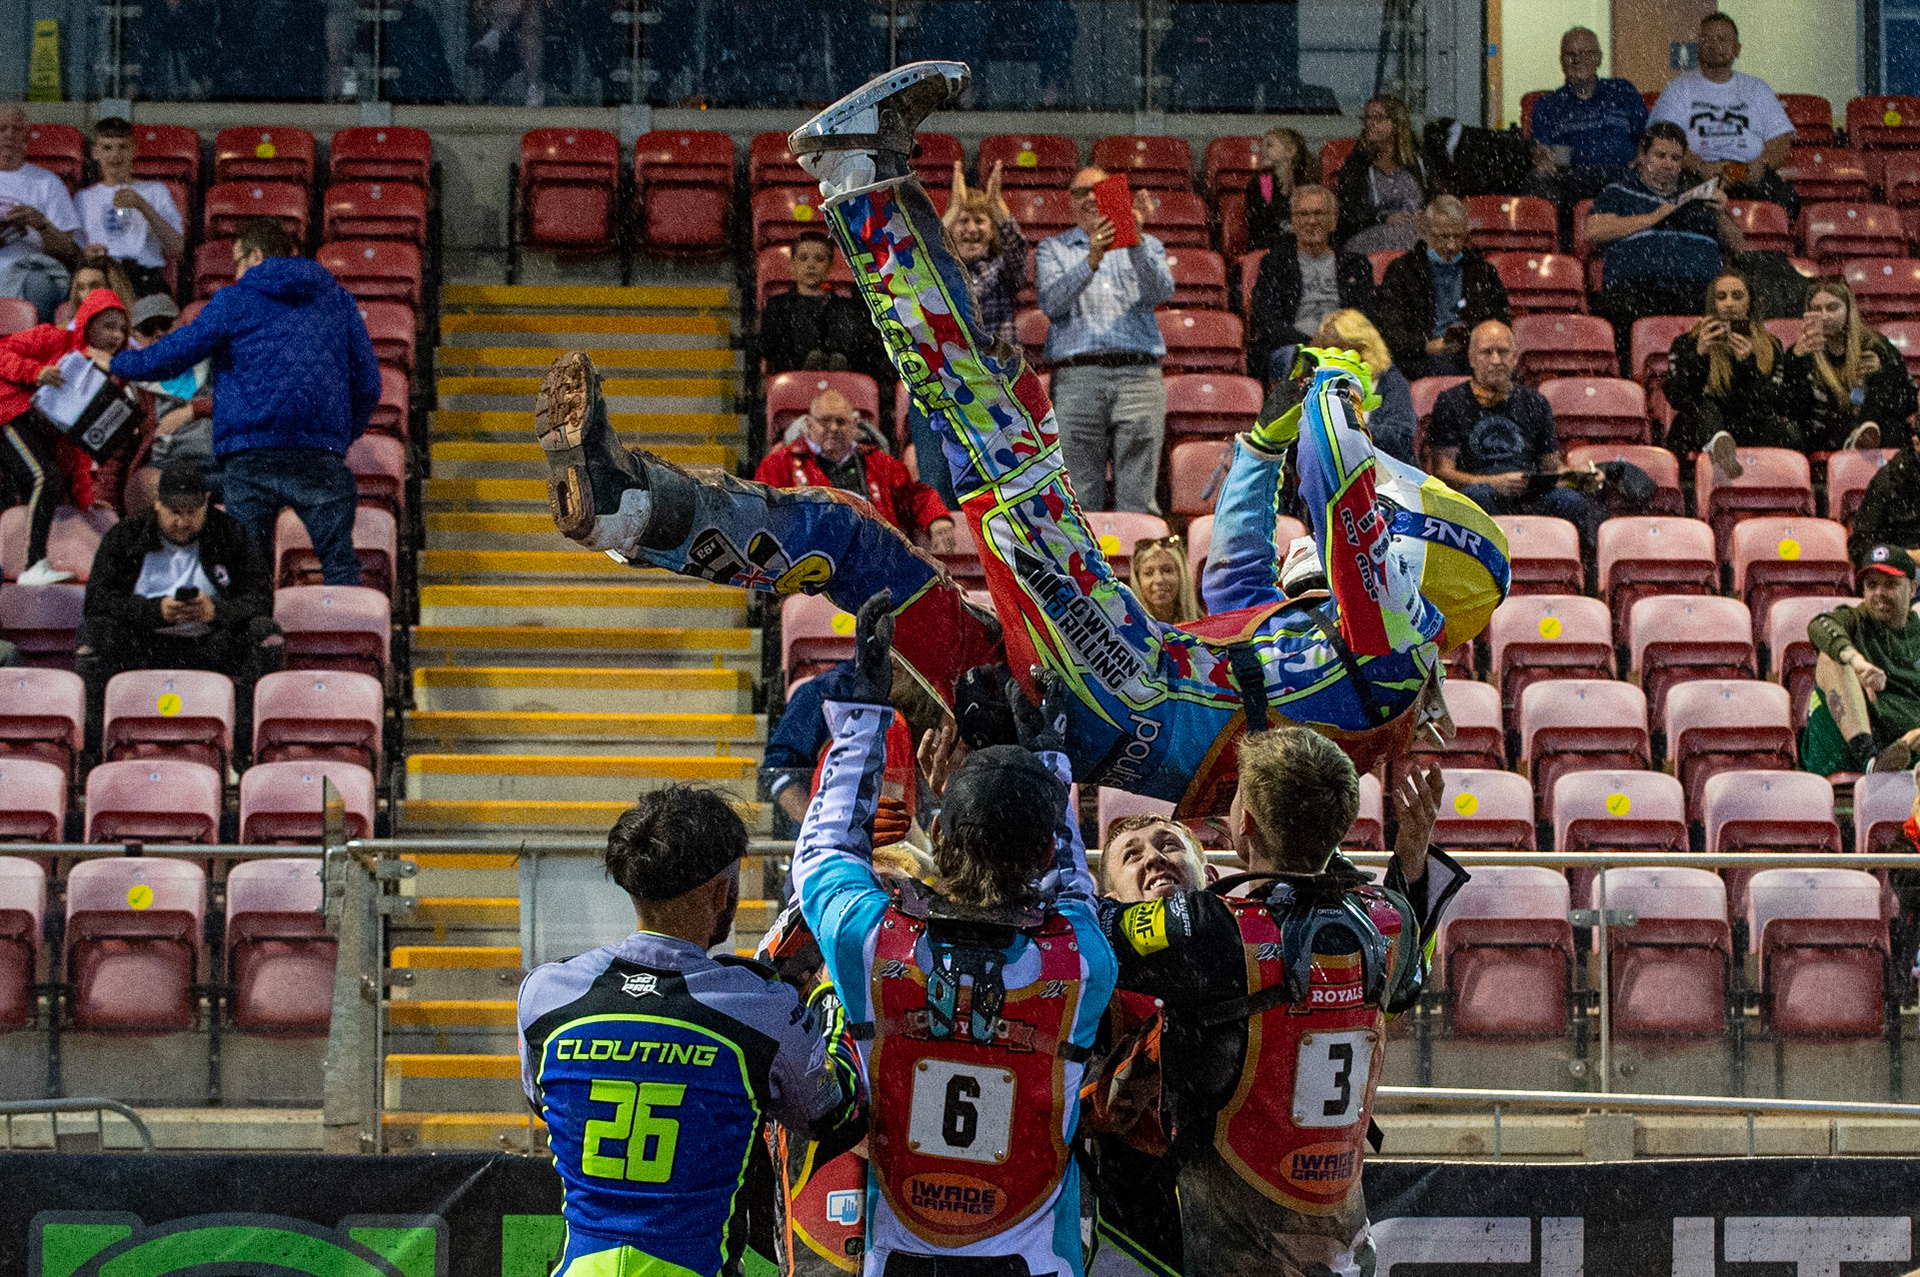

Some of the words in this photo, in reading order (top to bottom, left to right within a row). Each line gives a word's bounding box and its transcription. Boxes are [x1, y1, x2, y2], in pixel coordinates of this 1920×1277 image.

[850, 252, 957, 414] HAGON
[1341, 509, 1359, 546] Ray
[1421, 517, 1482, 556] RNR
[1045, 601, 1127, 689] DRILLING
[1056, 581, 1141, 678] BOWMAN
[621, 984, 656, 992] PRO
[1312, 987, 1364, 1003] ROYALS
[556, 1039, 719, 1066] CLOUTING
[1323, 1043, 1353, 1116] 3
[942, 1074, 980, 1148] 6
[582, 1079, 687, 1183] 26
[911, 1179, 996, 1204] IWADE
[911, 1195, 994, 1215] GARAGE
